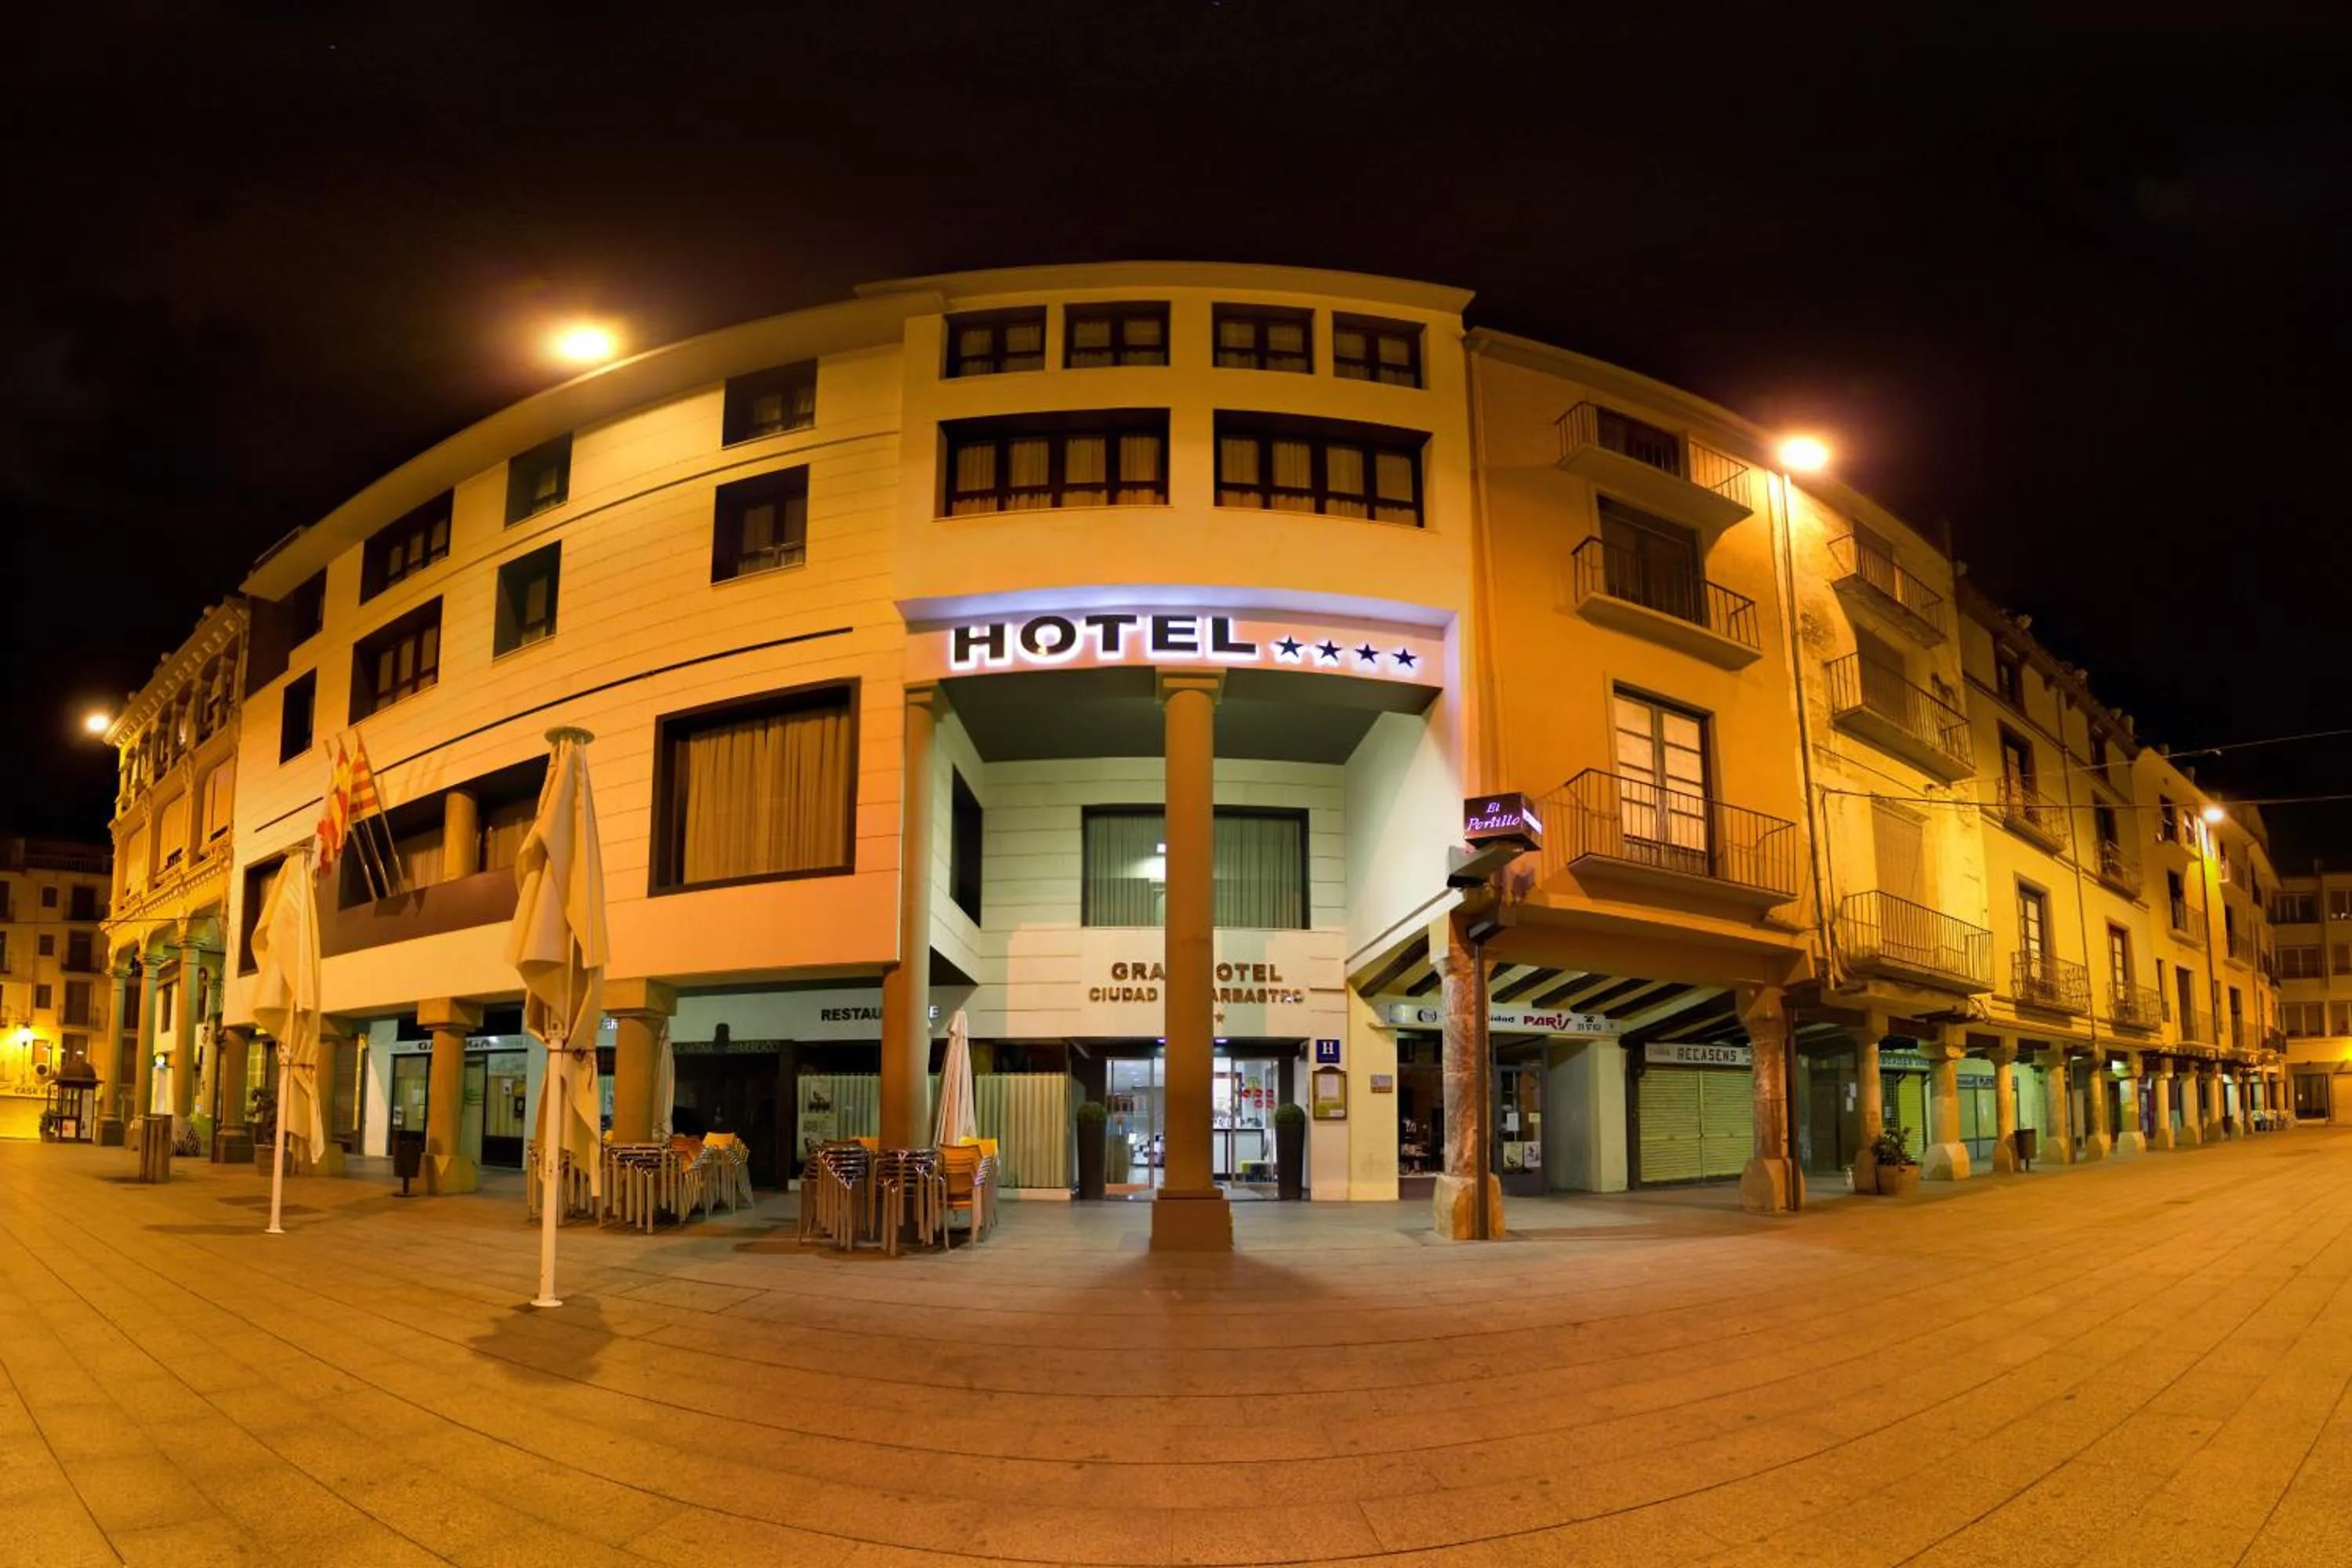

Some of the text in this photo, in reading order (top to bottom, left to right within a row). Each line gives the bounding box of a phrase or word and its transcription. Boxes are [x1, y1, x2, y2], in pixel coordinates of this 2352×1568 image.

[953, 615, 1256, 662] HOTEL
[1111, 962, 1283, 983] GRA OTEL
[1089, 986, 1305, 1004] CIUDAD ARBASTRO
[1322, 1040, 1334, 1054] H
[1677, 1047, 1737, 1062] RECASENS
